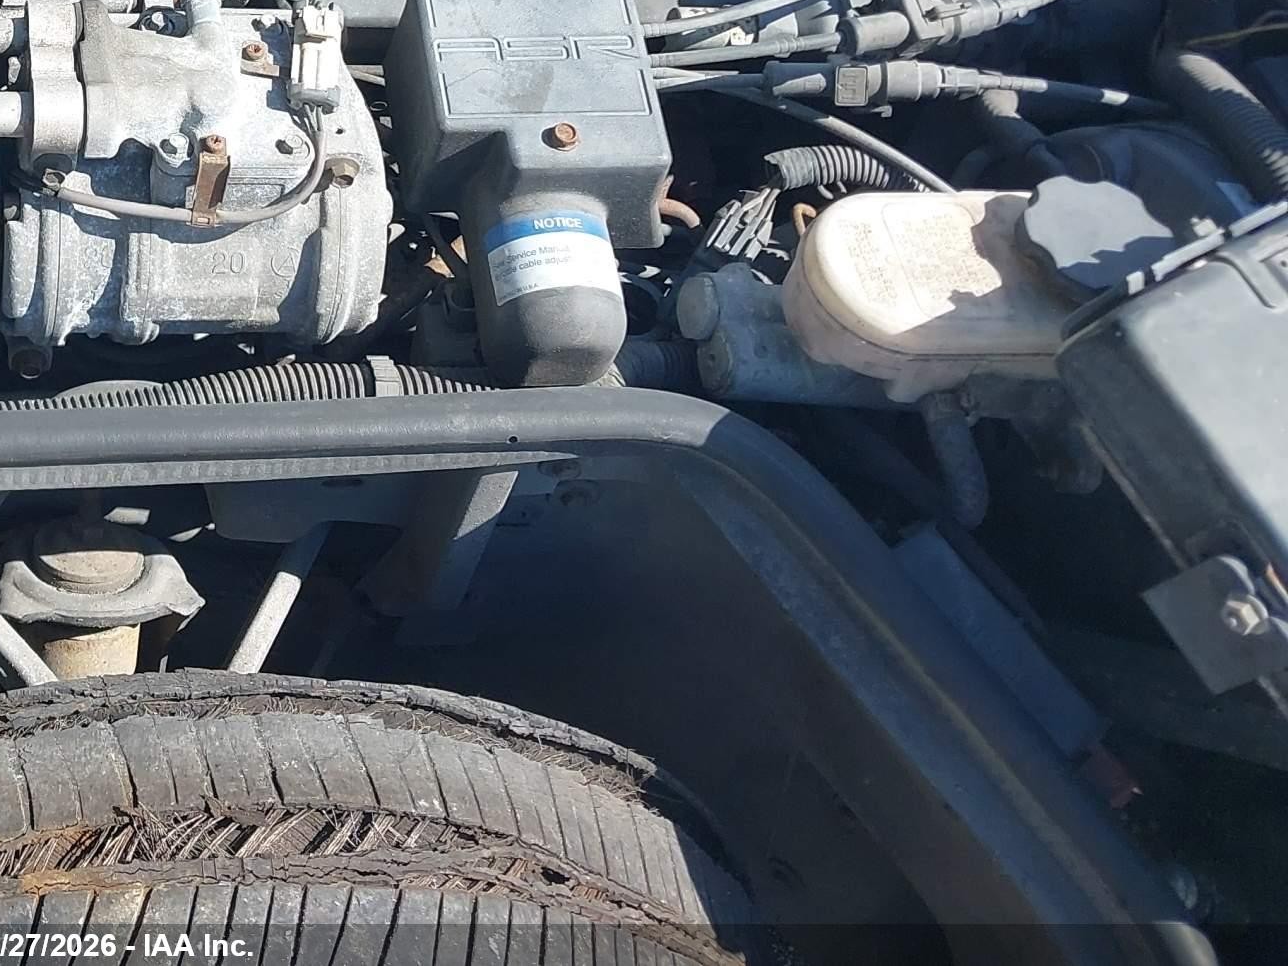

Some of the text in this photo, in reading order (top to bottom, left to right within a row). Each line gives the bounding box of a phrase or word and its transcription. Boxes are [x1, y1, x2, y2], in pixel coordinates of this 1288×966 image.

[433, 36, 640, 61] ASR
[533, 217, 584, 230] NOTICE
[506, 248, 537, 264] Service
[518, 259, 543, 271] cable
